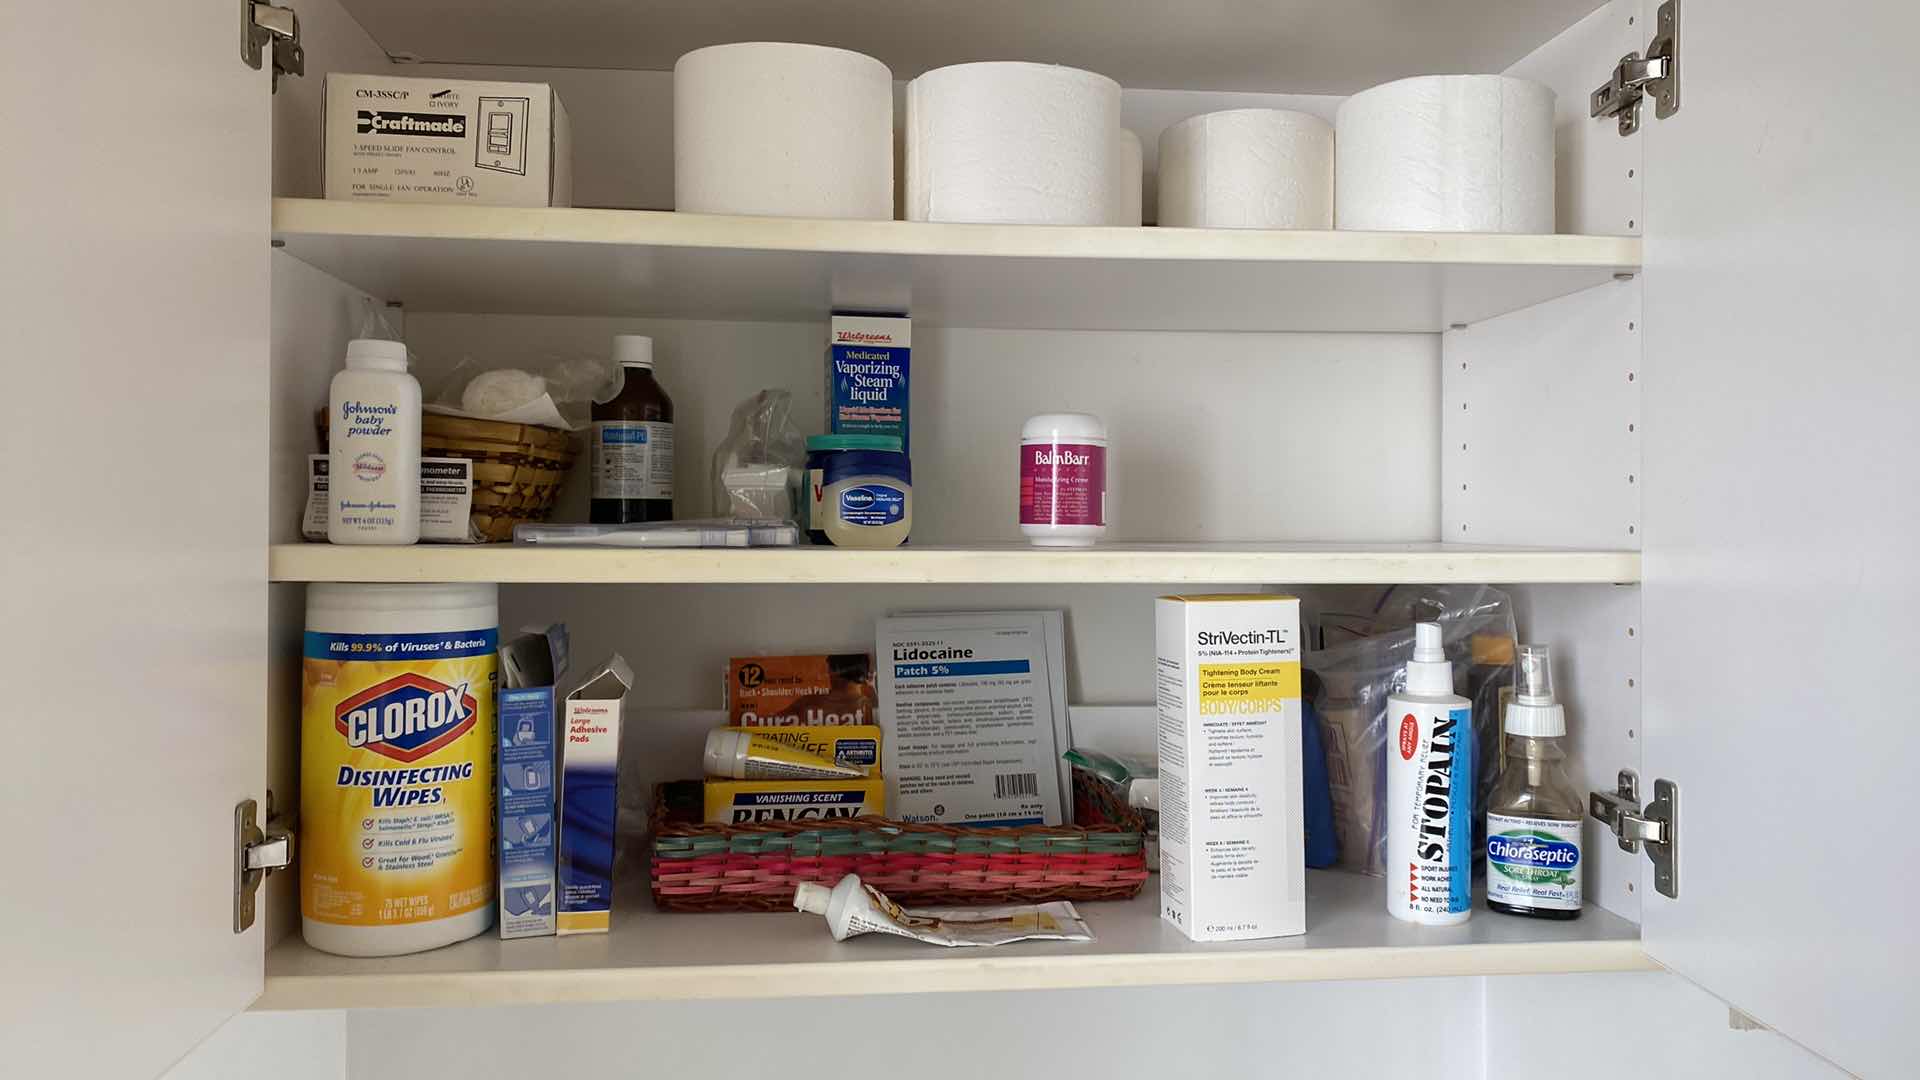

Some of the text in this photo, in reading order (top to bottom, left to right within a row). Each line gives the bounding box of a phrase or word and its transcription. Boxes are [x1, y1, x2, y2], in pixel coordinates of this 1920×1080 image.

[371, 116, 464, 133] Craftmade
[414, 185, 454, 193] OPERATION
[846, 351, 890, 360] Medicated
[836, 360, 900, 378] Vaporizing
[855, 374, 893, 388] Steam
[850, 387, 888, 404] liquid
[343, 400, 398, 420] Johnson's
[355, 415, 384, 427] baby
[347, 427, 392, 438] powder
[845, 494, 874, 502] Vaseline
[330, 641, 349, 651] Kills
[351, 642, 383, 652] 99.9%
[385, 641, 399, 653] of
[444, 641, 452, 650] &
[454, 638, 486, 650] Bacteria
[893, 648, 974, 661] Lidocaine
[742, 667, 761, 685] 12
[896, 665, 949, 676] Patch 5%
[1202, 669, 1239, 677] Tightening
[1228, 689, 1248, 697] corps
[1200, 698, 1281, 716] BODY/CORPS
[347, 682, 468, 748] CLOROX
[570, 717, 591, 726] Large
[570, 726, 608, 734] Adhesive
[569, 735, 590, 743] Pads
[337, 763, 473, 787] DISINFECTING
[1414, 765, 1426, 810] TEMPORARY
[1417, 716, 1457, 863] STOPAIN
[372, 786, 442, 808] WIPES
[756, 793, 844, 804] VANISHING SCENT
[1411, 814, 1420, 830] FOR
[378, 839, 393, 847] Kills
[395, 838, 411, 846] Cold
[1488, 840, 1576, 866] Chloraseptic
[418, 860, 433, 868] Steel
[1526, 866, 1559, 878] THROAT
[1532, 887, 1548, 896] Real
